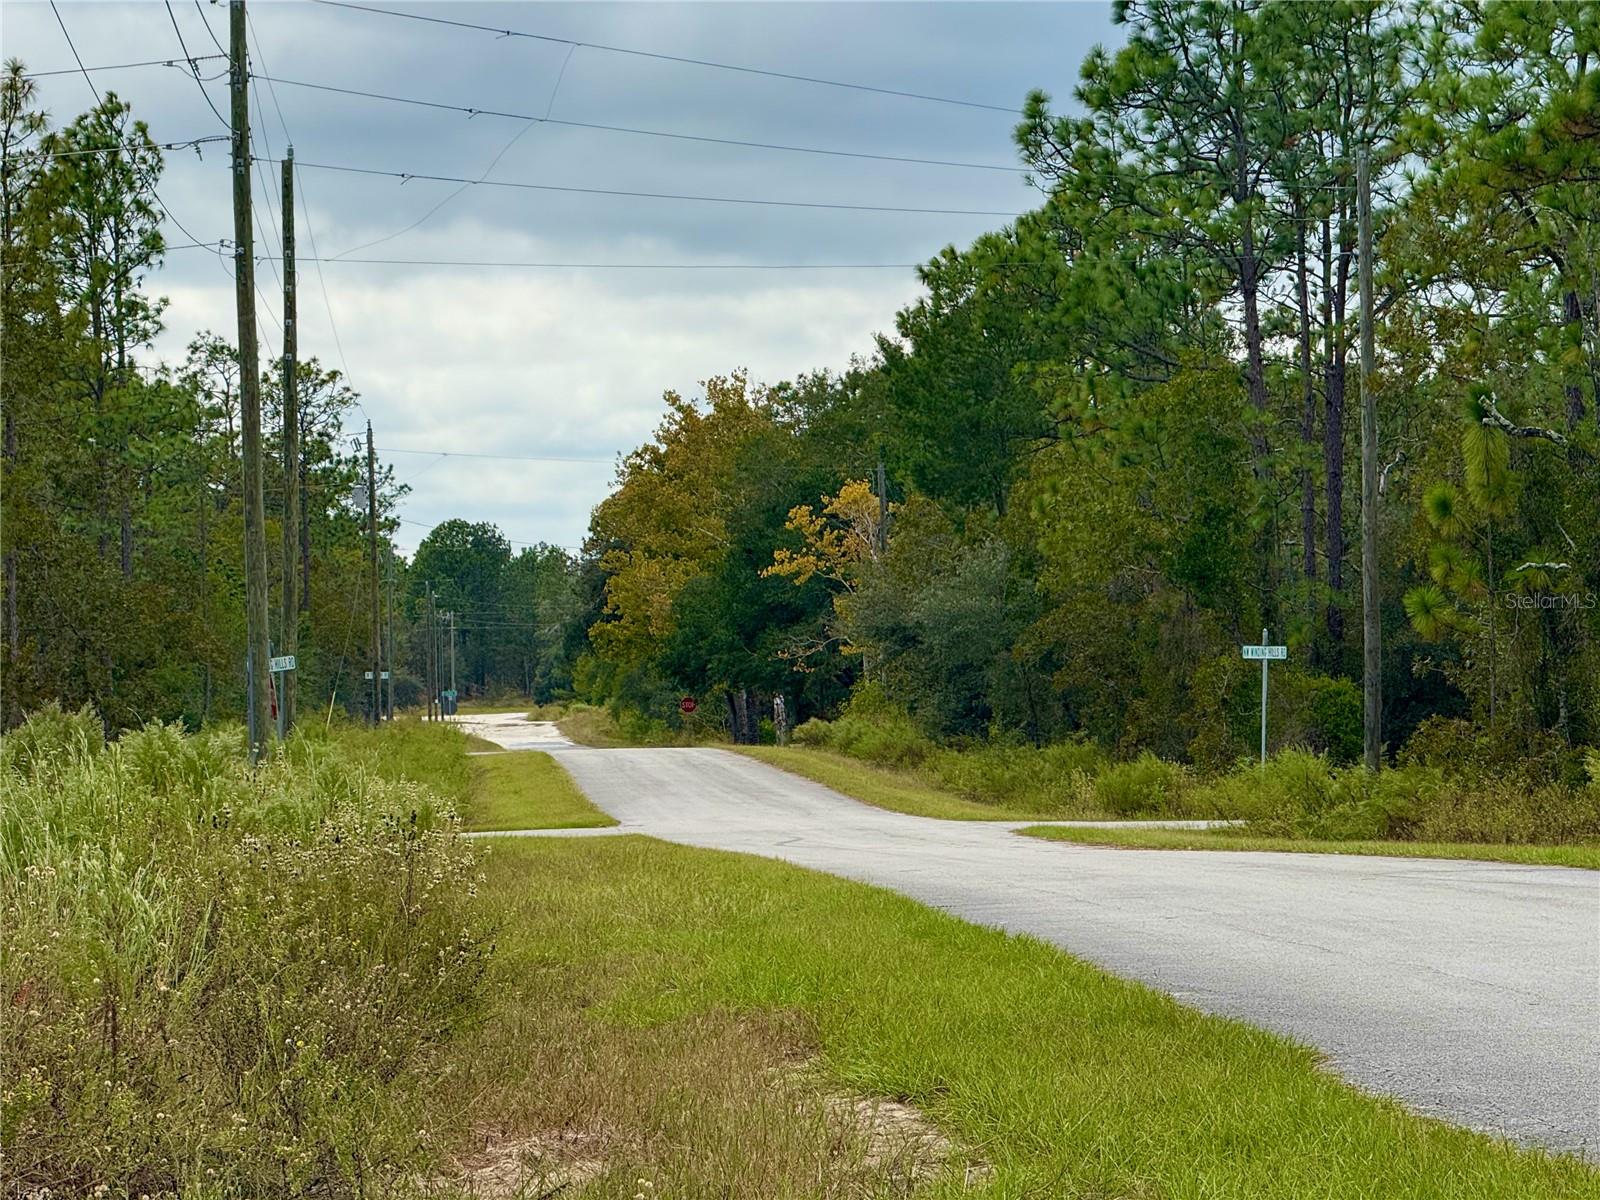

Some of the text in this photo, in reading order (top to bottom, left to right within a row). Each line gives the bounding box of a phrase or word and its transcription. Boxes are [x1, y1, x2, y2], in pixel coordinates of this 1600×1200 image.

[1250, 647, 1267, 657] WINDING
[1268, 647, 1279, 657] HILLS
[1280, 647, 1286, 657] RD
[274, 657, 286, 668] HILLS
[288, 656, 294, 667] RD
